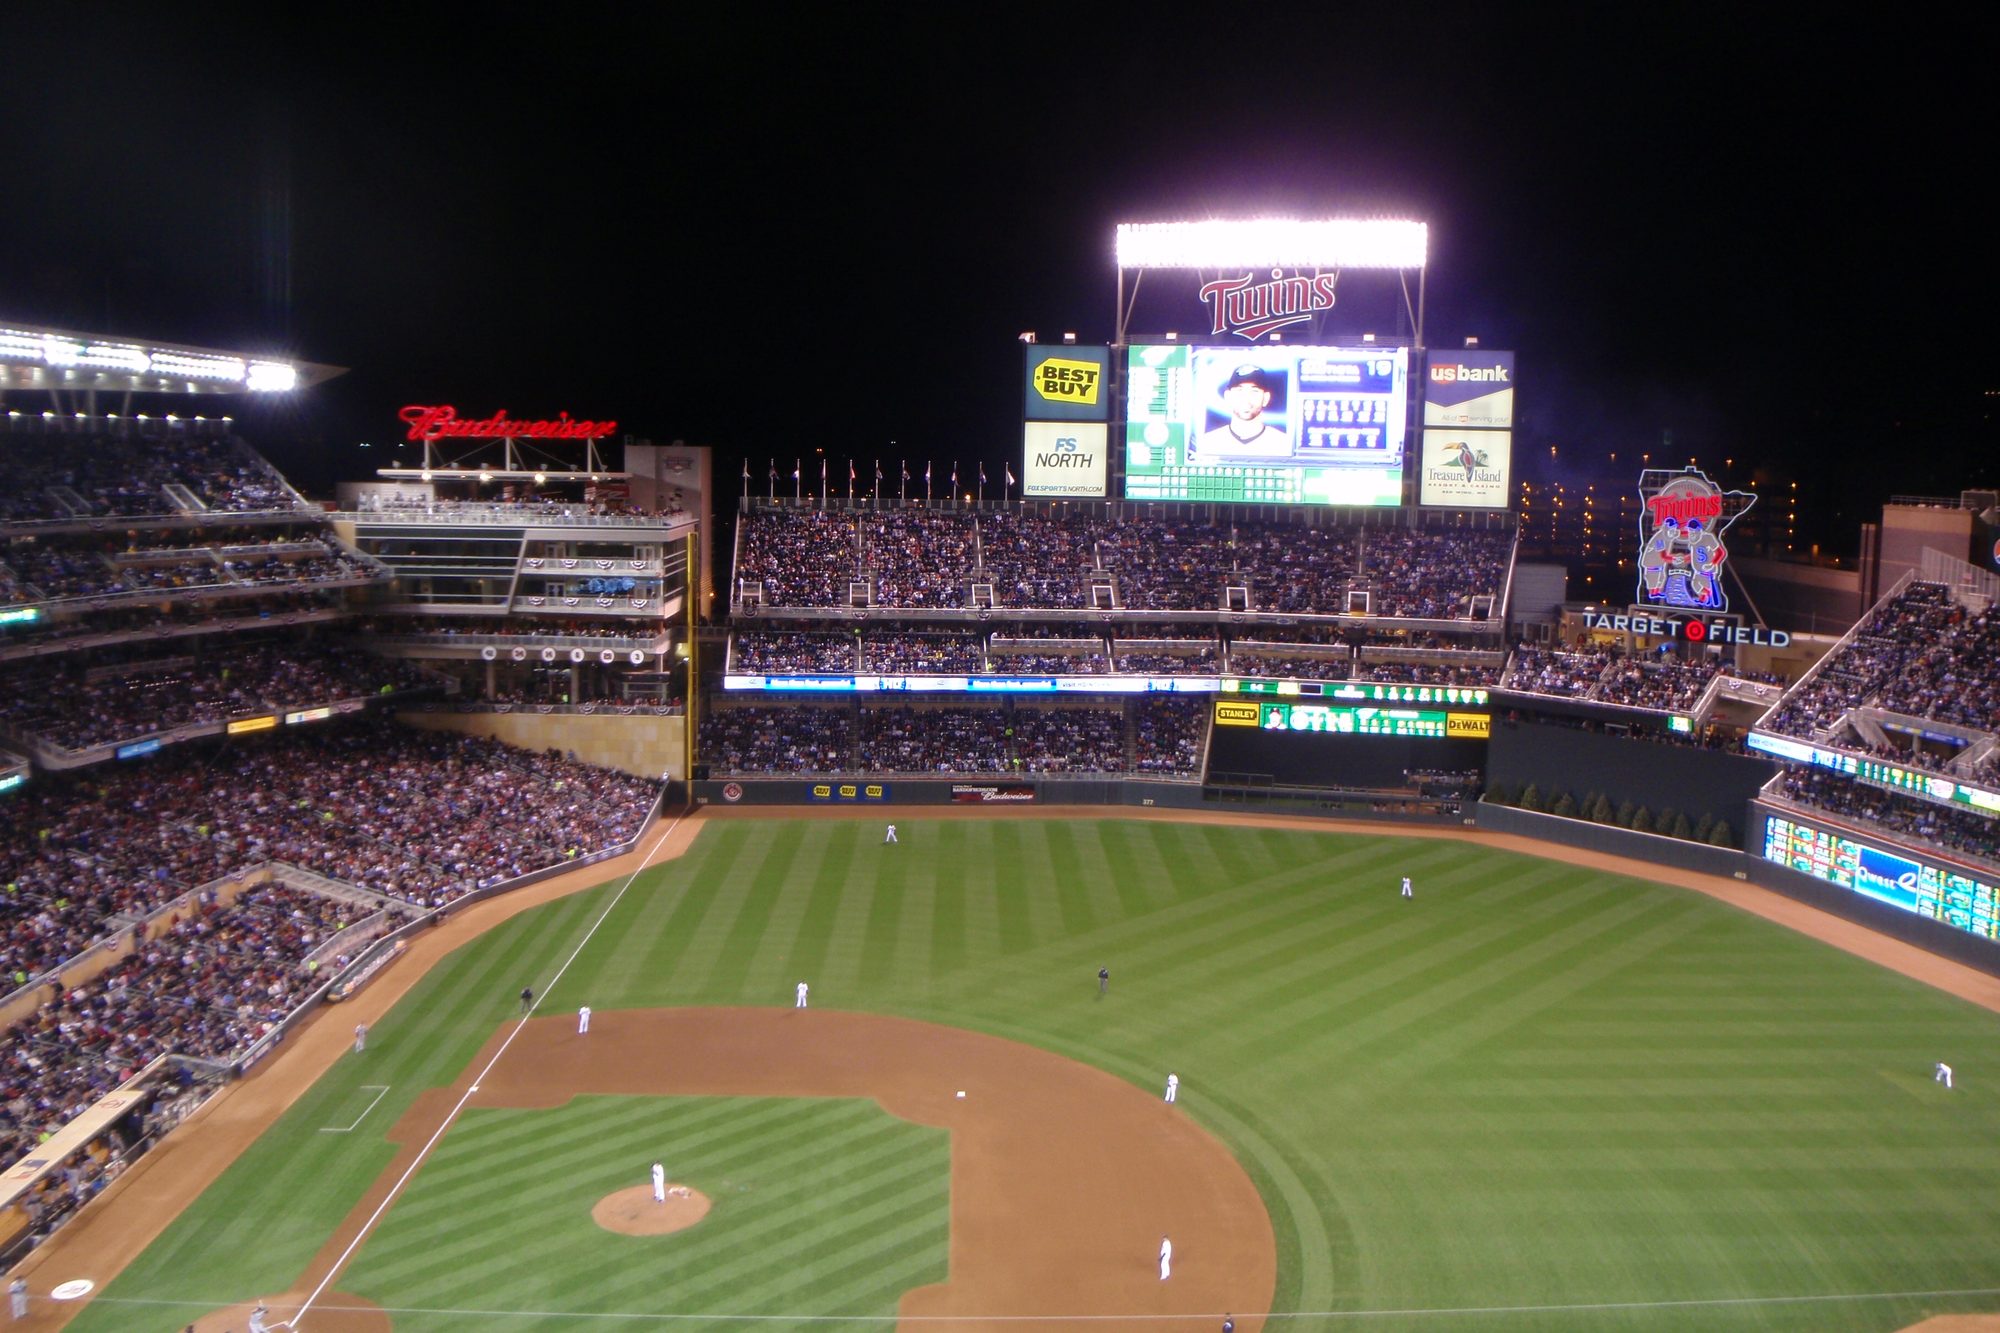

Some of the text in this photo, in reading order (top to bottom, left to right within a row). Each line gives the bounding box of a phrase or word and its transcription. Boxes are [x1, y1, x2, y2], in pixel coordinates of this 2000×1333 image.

[1199, 268, 1335, 335] Twins
[1042, 365, 1098, 384] BEST
[1043, 379, 1092, 397] BUY
[399, 404, 618, 441] Budweiser
[1055, 437, 1077, 453] FS
[1035, 452, 1093, 469] NORTH
[1427, 467, 1501, 482] Treasure Island
[1647, 489, 1722, 528] Twins
[1582, 612, 1790, 648] TARGET FIELD
[1220, 709, 1255, 718] STANLEY
[980, 790, 1035, 801] Budweiser
[1856, 865, 1897, 890] Qwest
